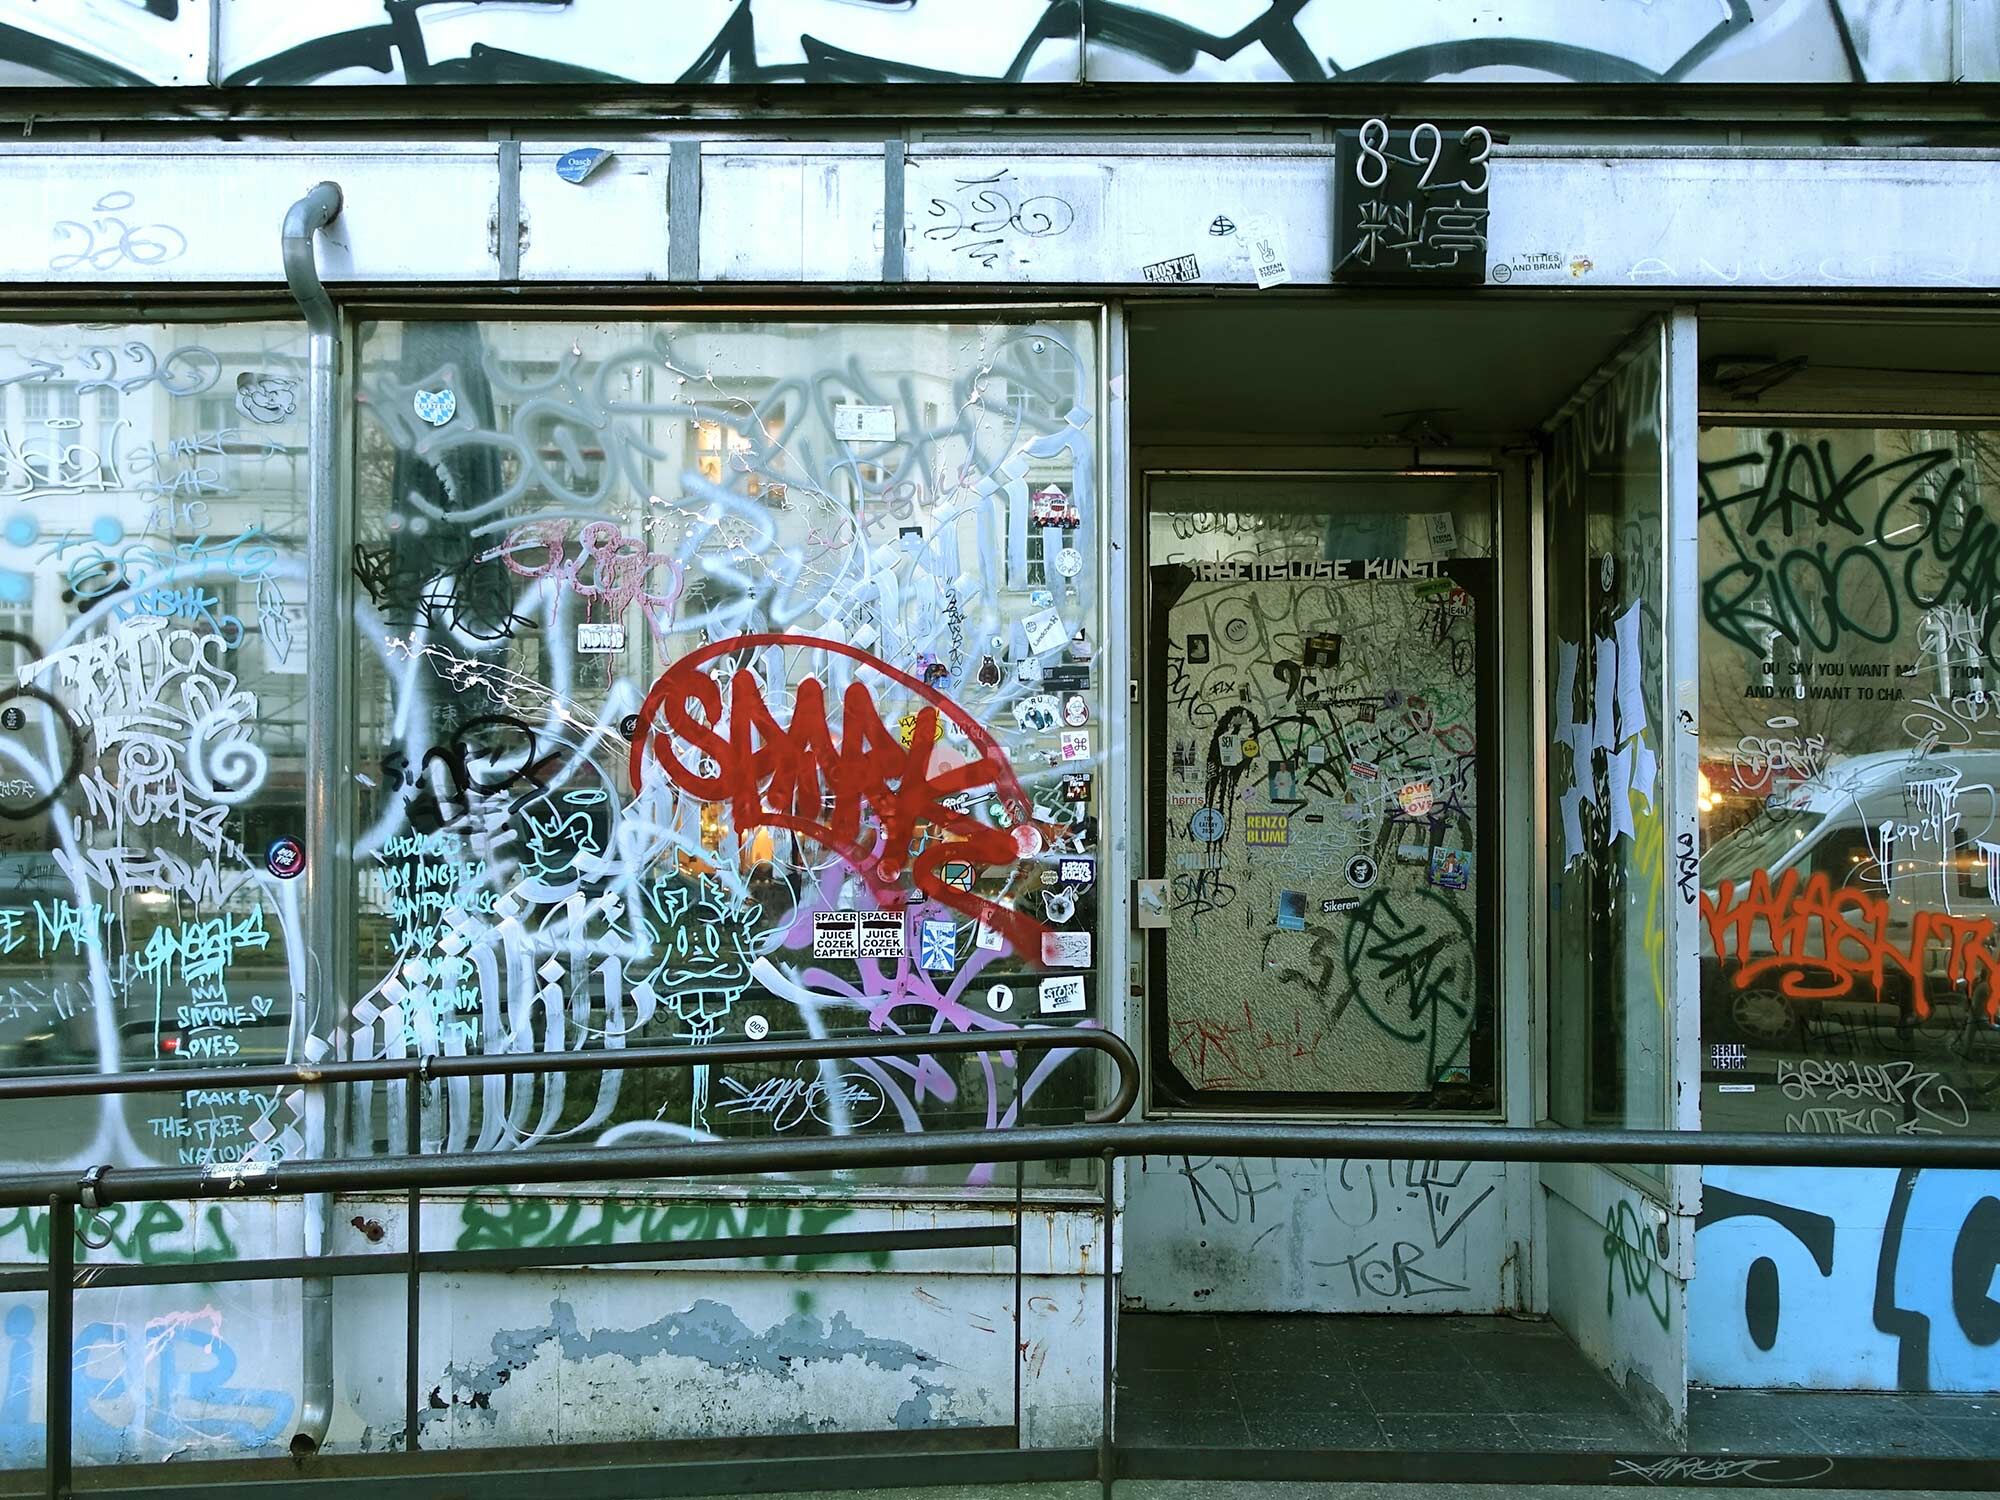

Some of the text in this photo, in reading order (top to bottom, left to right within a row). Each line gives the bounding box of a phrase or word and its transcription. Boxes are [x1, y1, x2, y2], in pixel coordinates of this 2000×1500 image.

[1356, 118, 1492, 195] 893
[1144, 255, 1198, 281] FROST187
[1512, 263, 1562, 272] AND BRIAN
[1787, 661, 1814, 677] SAY
[1816, 662, 1844, 677] YOU
[1849, 663, 1890, 678] WANT
[1744, 685, 1775, 699] AND
[1777, 685, 1806, 700] YOU
[1809, 686, 1851, 700] WANT
[1857, 687, 1874, 700] TO
[1397, 782, 1431, 797] LOVE
[1246, 815, 1288, 829] RENZO
[1246, 829, 1288, 843] BLUME
[1060, 870, 1092, 883] ROCKS
[1323, 899, 1361, 913] Sikerem
[814, 913, 857, 921] SPACER
[860, 912, 903, 920] SPACER
[819, 931, 853, 940] JUICE
[865, 930, 899, 939] JUICE
[816, 940, 855, 949] COZEK
[863, 939, 901, 948] COZEK
[814, 949, 858, 957] CAPTEK
[860, 948, 905, 956] CAPTEK
[177, 1004, 257, 1030] SIMONE
[174, 1035, 240, 1059] LOVES
[1711, 1044, 1747, 1057] BERLIN
[1711, 1057, 1746, 1070] DESIGN
[147, 1115, 246, 1142] THE FREE
